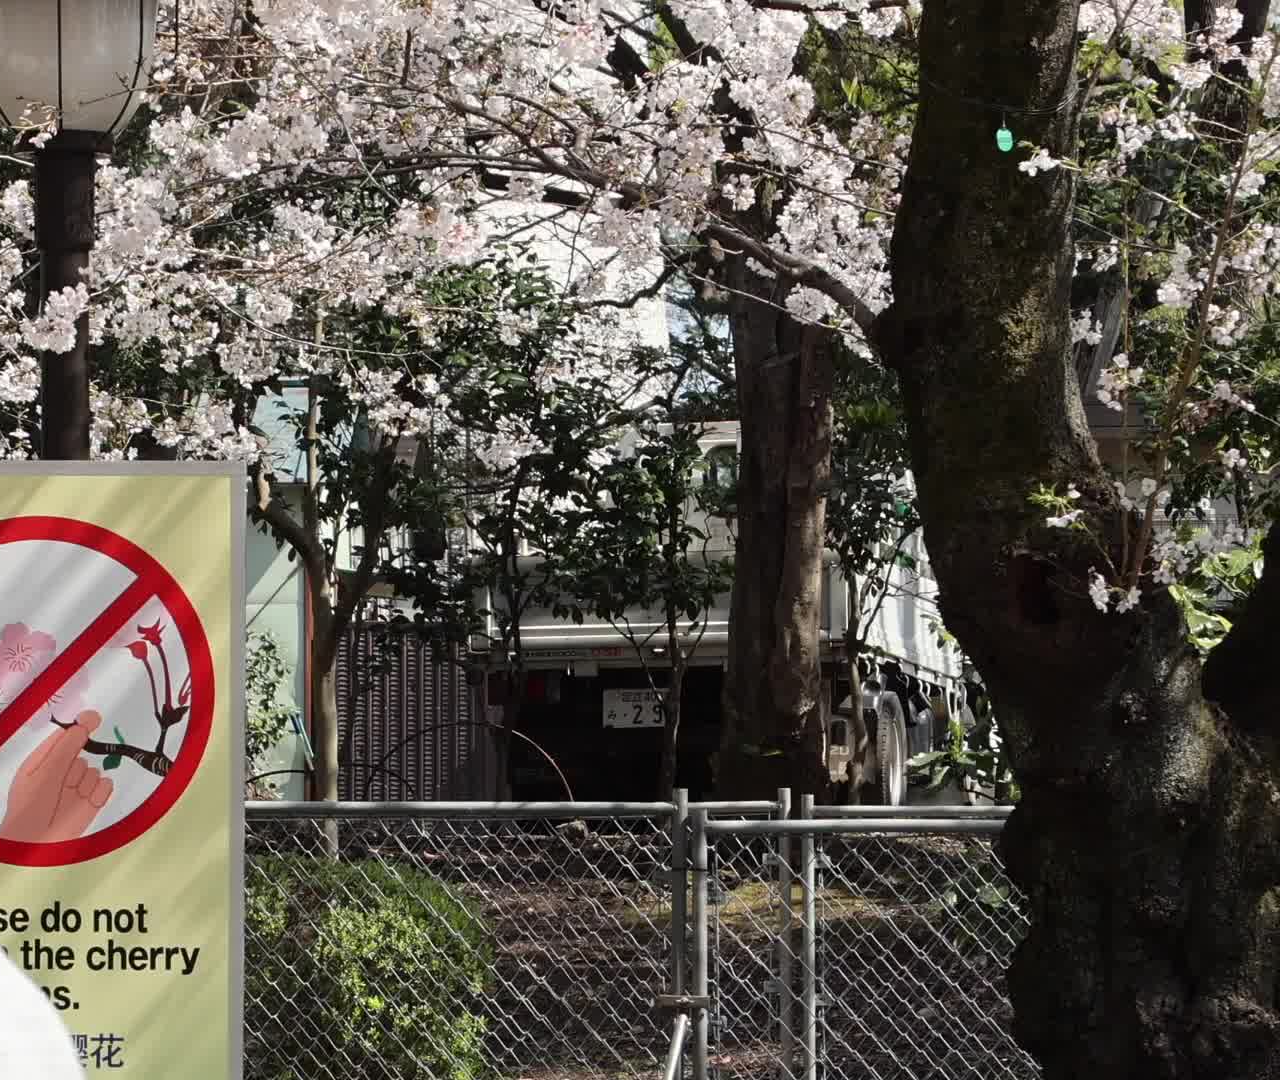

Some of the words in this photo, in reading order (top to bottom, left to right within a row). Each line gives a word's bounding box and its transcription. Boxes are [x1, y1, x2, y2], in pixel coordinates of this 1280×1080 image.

[40, 901, 82, 933] do
[93, 904, 148, 933] not
[20, 939, 75, 971] the
[86, 939, 200, 975] cherry
